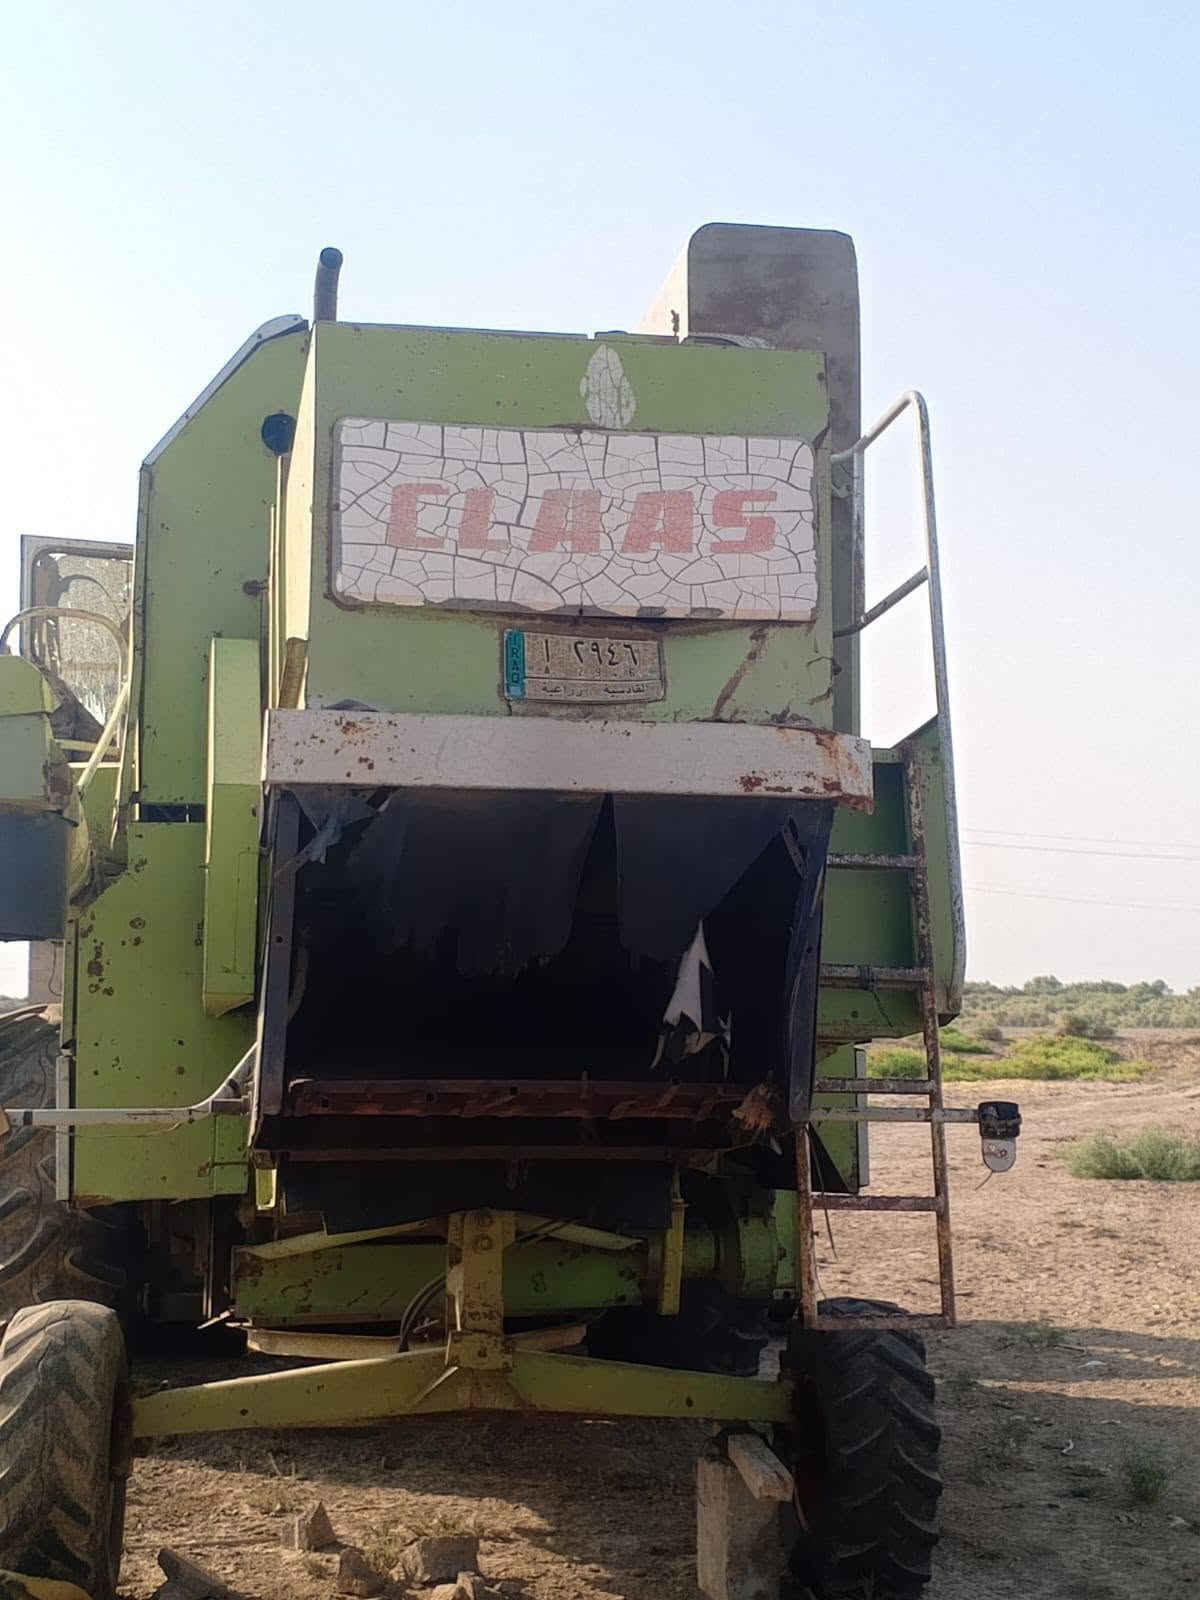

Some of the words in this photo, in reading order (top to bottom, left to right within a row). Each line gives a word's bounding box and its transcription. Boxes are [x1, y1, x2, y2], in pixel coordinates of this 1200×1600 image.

[386, 483, 777, 553] CLAAS
[509, 633, 519, 684] IRAQ
[574, 641, 638, 666] ٢٩٤٦
[603, 684, 648, 697] القادسية
